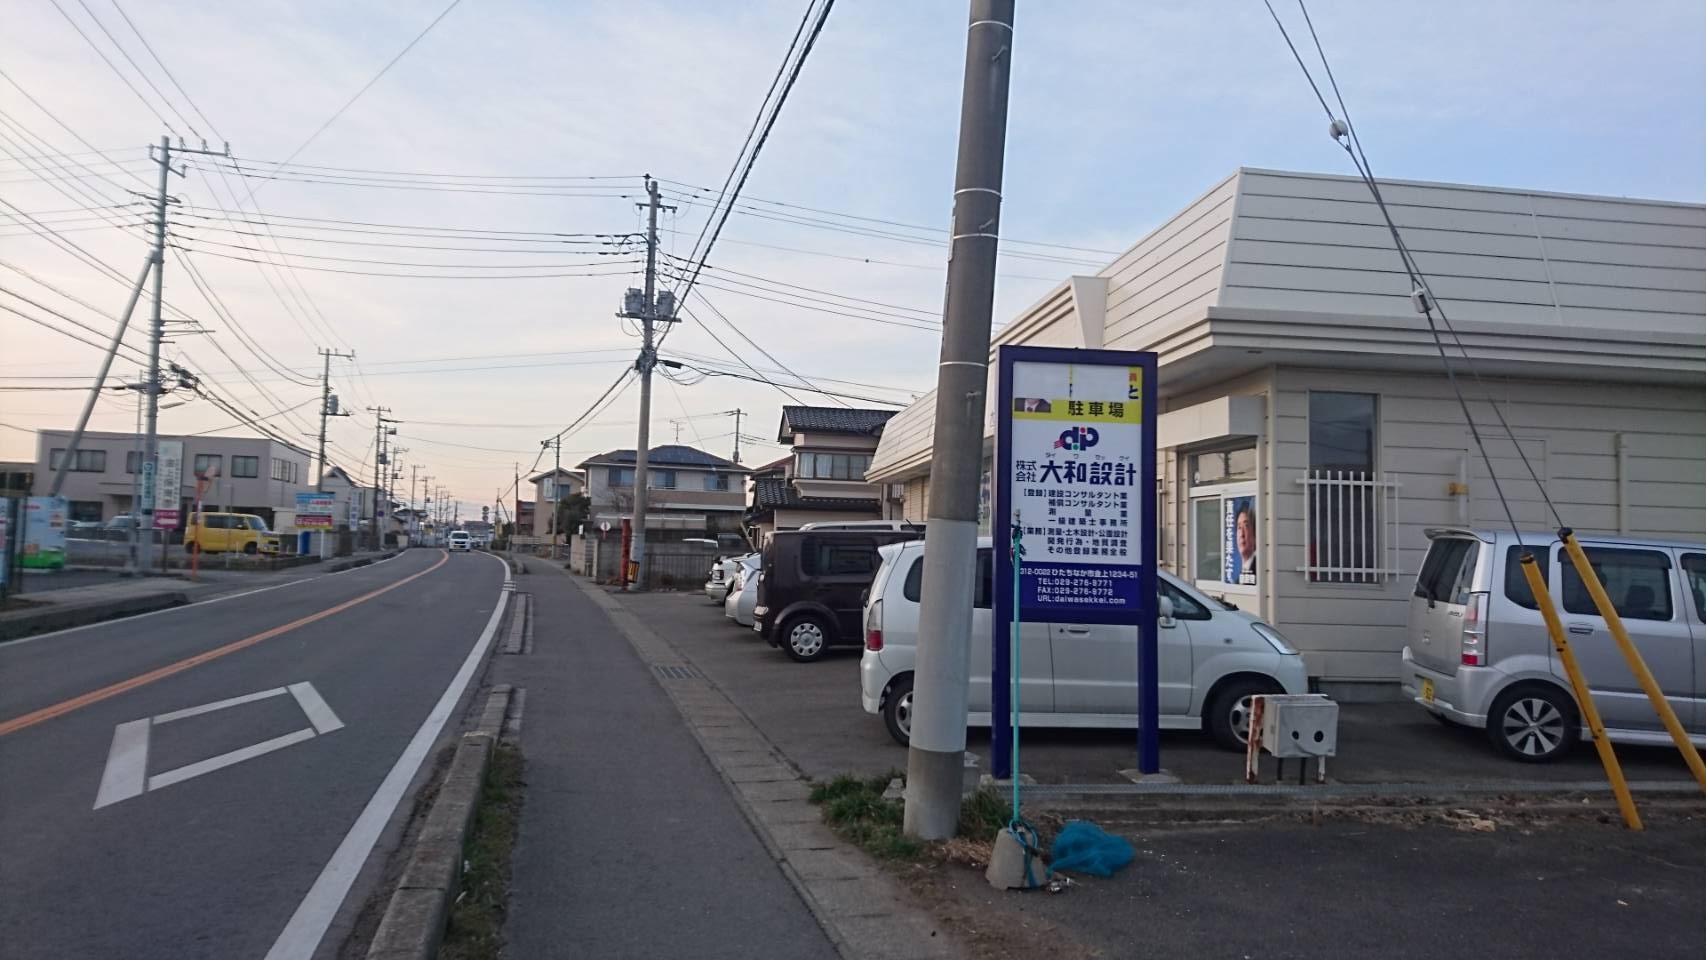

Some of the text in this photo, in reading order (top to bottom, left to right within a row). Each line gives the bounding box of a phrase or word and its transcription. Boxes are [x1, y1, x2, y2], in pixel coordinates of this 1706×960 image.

[1068, 400, 1124, 418] 駐車場
[1039, 460, 1137, 486] 大和設計
